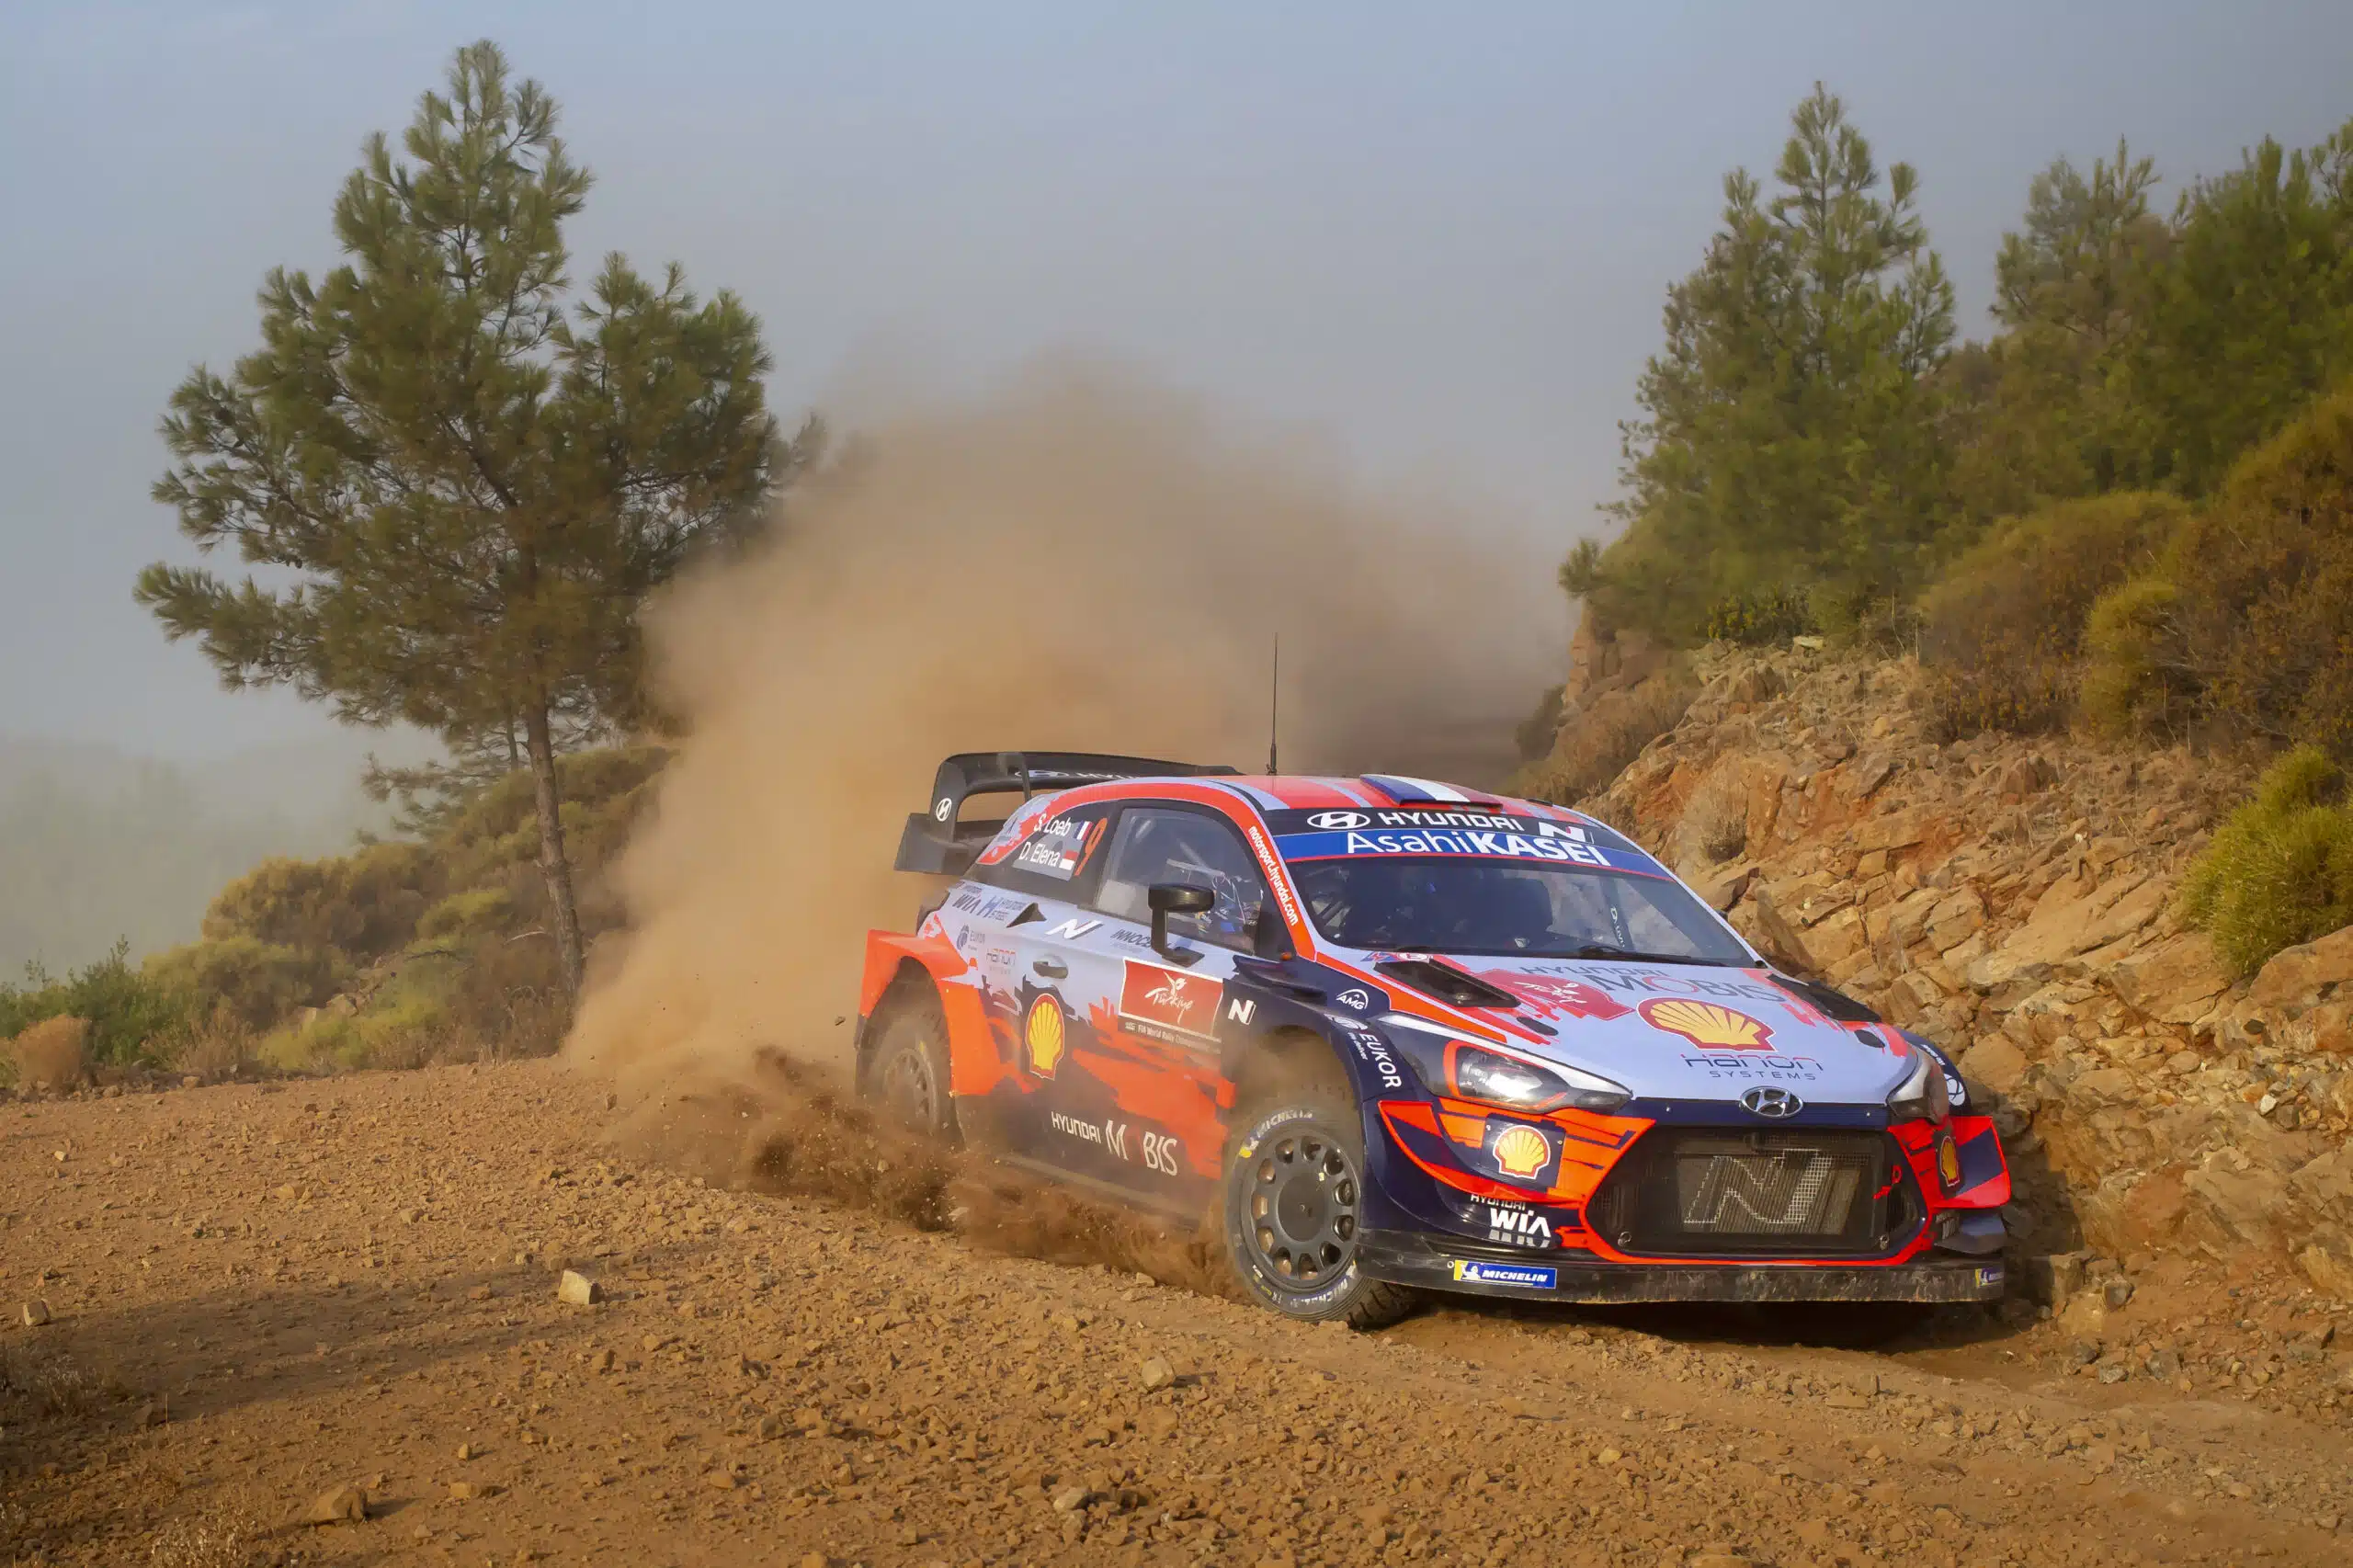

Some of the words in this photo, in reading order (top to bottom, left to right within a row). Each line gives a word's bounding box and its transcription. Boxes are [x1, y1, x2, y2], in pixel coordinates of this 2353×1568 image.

[1033, 813, 1047, 832] S.
[1044, 815, 1072, 836] Loeb
[1379, 812, 1525, 831] HYUNDAI
[1018, 841, 1031, 860] D.
[1029, 843, 1061, 867] Elena
[1347, 831, 1611, 866] AsahiKASEI
[1248, 825, 1299, 926] motorsport.hyundai.com
[1518, 966, 1671, 977] HYUNDAI
[1336, 994, 1365, 1010] AMG
[1585, 974, 1785, 1003] MOBIS
[1227, 998, 1256, 1026] N
[1359, 1033, 1402, 1088] EUKOR
[1709, 1070, 1817, 1081] SYSTEMS
[1051, 1110, 1102, 1144] HYUNDAI
[1490, 1207, 1552, 1238] WIA
[1482, 1269, 1548, 1282] MICHELIN
